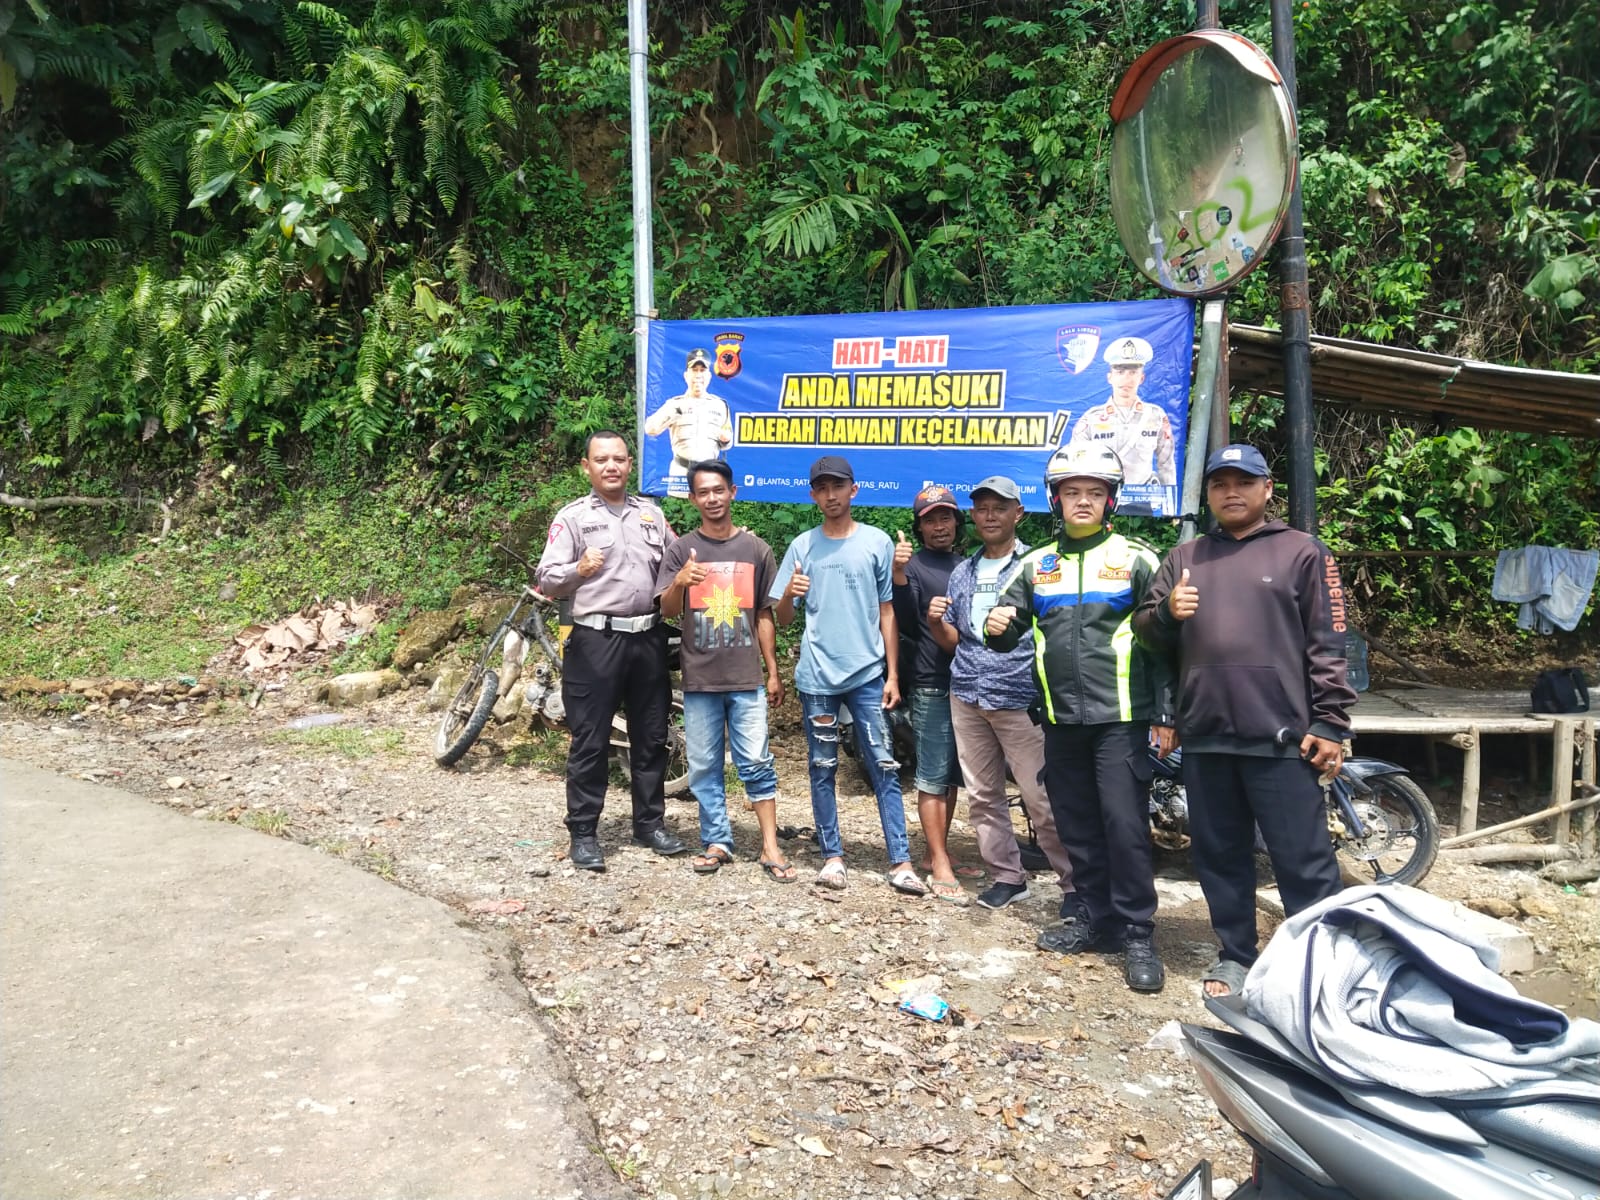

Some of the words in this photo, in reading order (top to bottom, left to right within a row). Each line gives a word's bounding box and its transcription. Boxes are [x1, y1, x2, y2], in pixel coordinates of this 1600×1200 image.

[783, 376, 850, 407] ANDA
[855, 374, 1000, 407] MEMASUKI
[740, 417, 816, 444] DAERAH
[818, 417, 896, 444] RAWAN
[1100, 570, 1128, 578] POLRI
